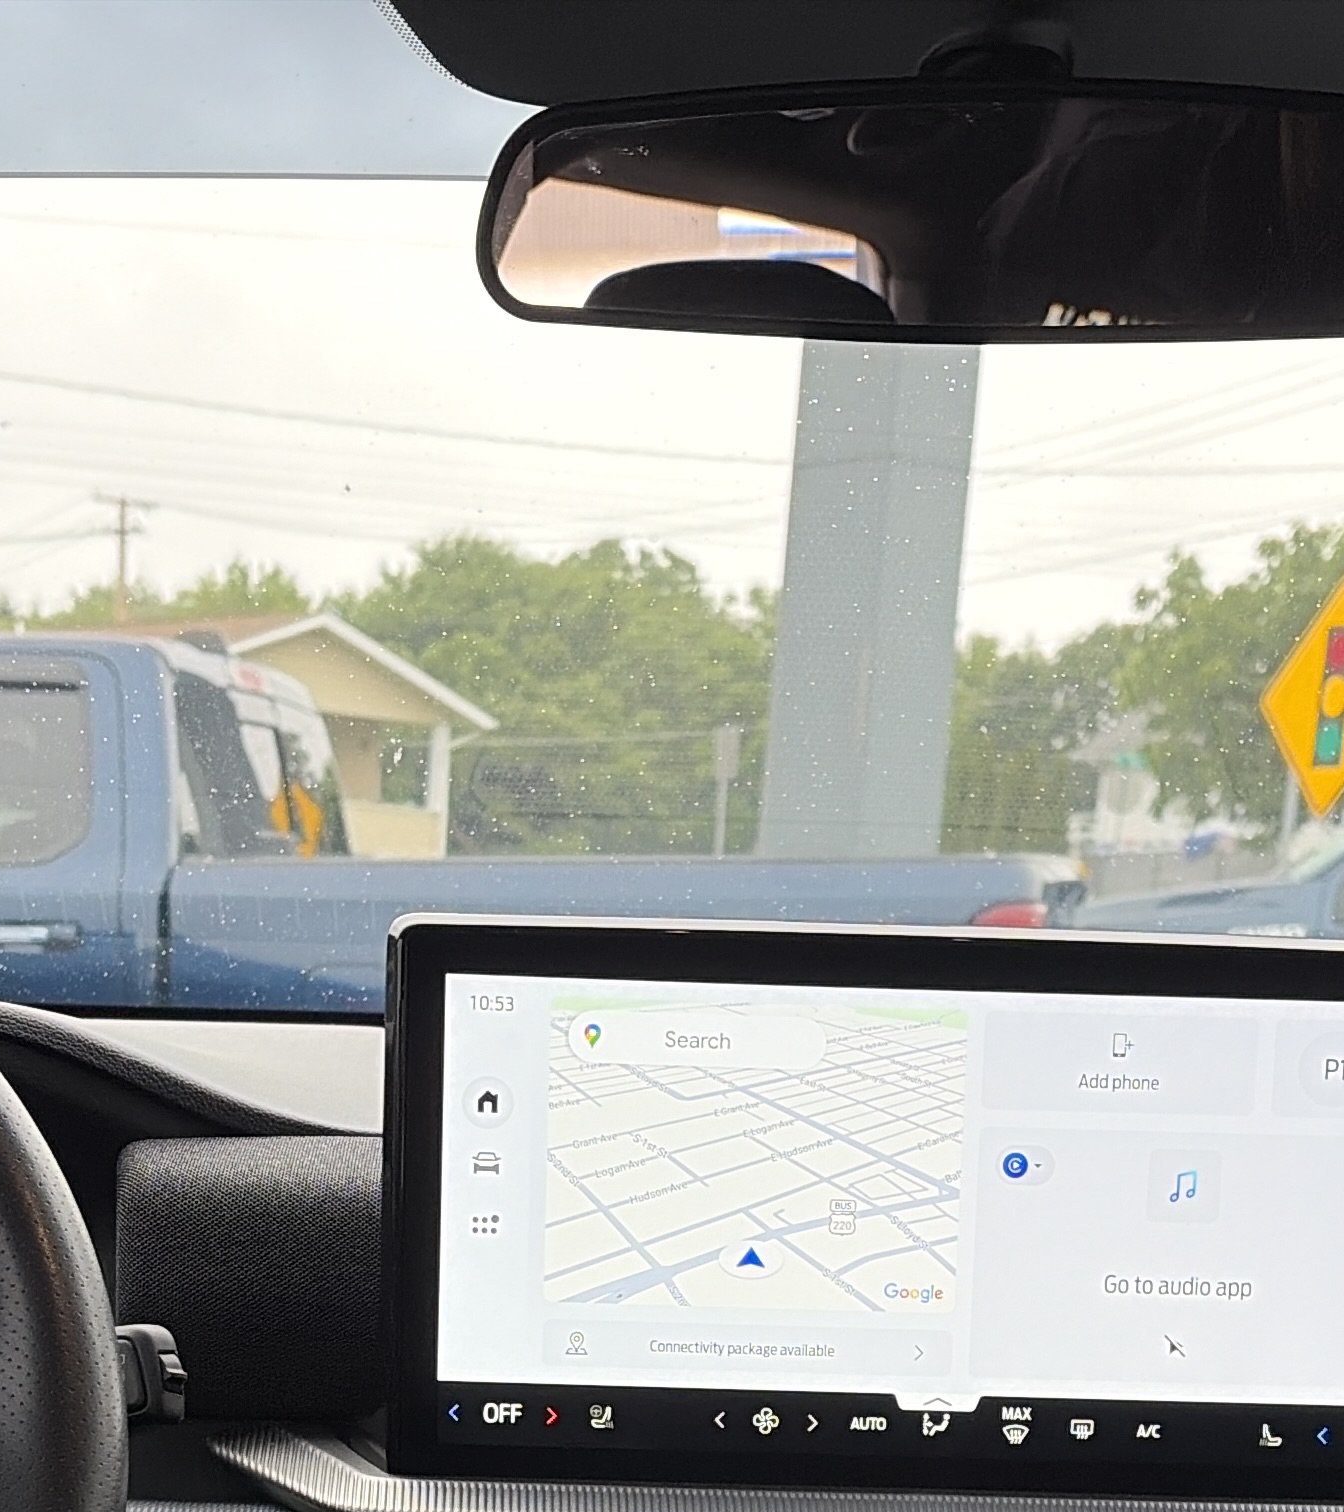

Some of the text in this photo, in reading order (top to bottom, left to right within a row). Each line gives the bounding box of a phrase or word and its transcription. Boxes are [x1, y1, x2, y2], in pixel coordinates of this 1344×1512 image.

[469, 995, 514, 1012] 10:53
[664, 1030, 732, 1050] Search
[1078, 1073, 1160, 1092] Add phone
[572, 1132, 618, 1149] Grant Ave
[779, 1143, 814, 1160] Hudson
[815, 1138, 833, 1149] Ave
[594, 1156, 646, 1178] Logan Ave
[629, 1180, 688, 1205] Hudson Ave
[834, 1201, 852, 1210] BUS
[832, 1220, 852, 1231] 220
[884, 1282, 944, 1303] Google
[1104, 1274, 1253, 1300] Go to audio app
[649, 1339, 836, 1358] Connectivity package available
[482, 1402, 523, 1424] OFF
[1001, 1406, 1032, 1421] MAX
[850, 1416, 887, 1431] AUTO
[1136, 1424, 1162, 1439] A/C
